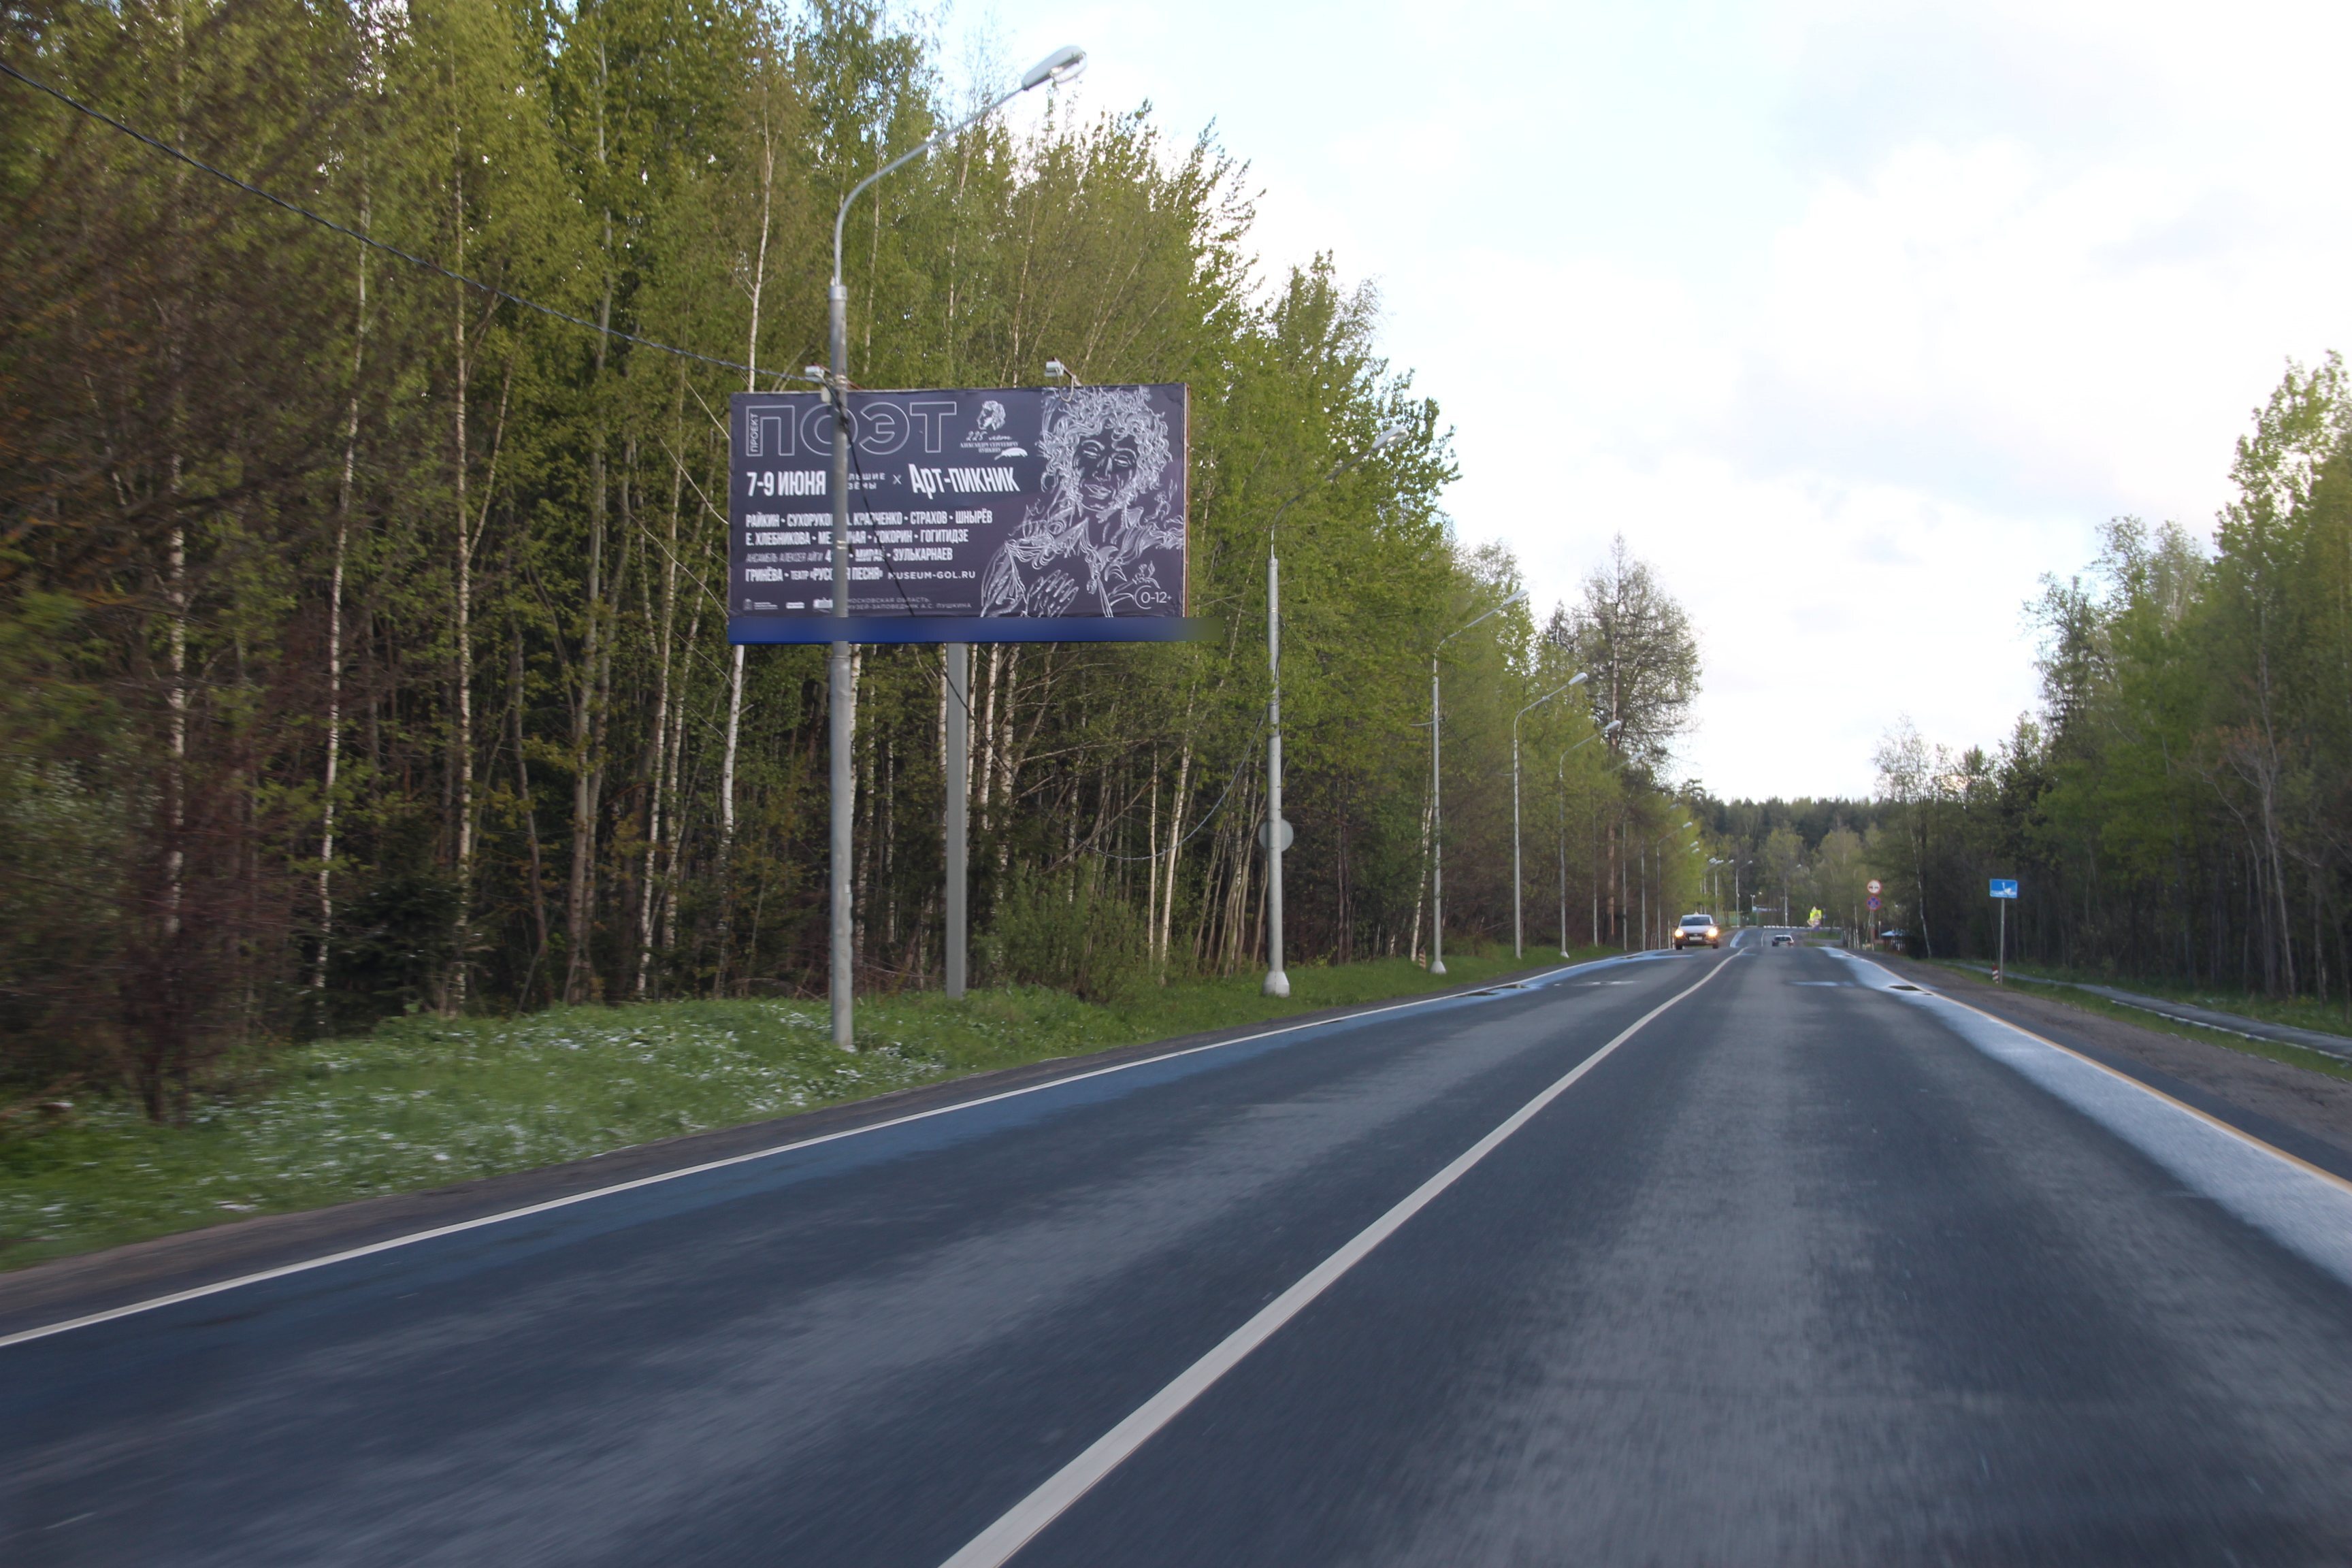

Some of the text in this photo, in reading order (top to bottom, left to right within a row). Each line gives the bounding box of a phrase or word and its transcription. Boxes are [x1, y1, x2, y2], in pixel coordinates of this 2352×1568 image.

[746, 402, 957, 457] ПОЭТ
[749, 413, 759, 453] ПРОЕКТ
[965, 431, 987, 442] 225
[747, 470, 826, 497] 7-9 ИЮНЯ
[848, 472, 885, 480] ЛЬШИЕ
[745, 512, 780, 527] РАЙКИН
[910, 510, 947, 525] СТРАХОВ
[955, 508, 992, 525] ШНЫРЁВ
[745, 532, 754, 546] Е.
[755, 531, 811, 545] ХЛЕБНИКОВА
[920, 528, 968, 544] ГОГИТИДЗЕ
[892, 547, 953, 561] ЗУЛЬКАРНАЕВ
[745, 566, 783, 582] ГРИНЁВА
